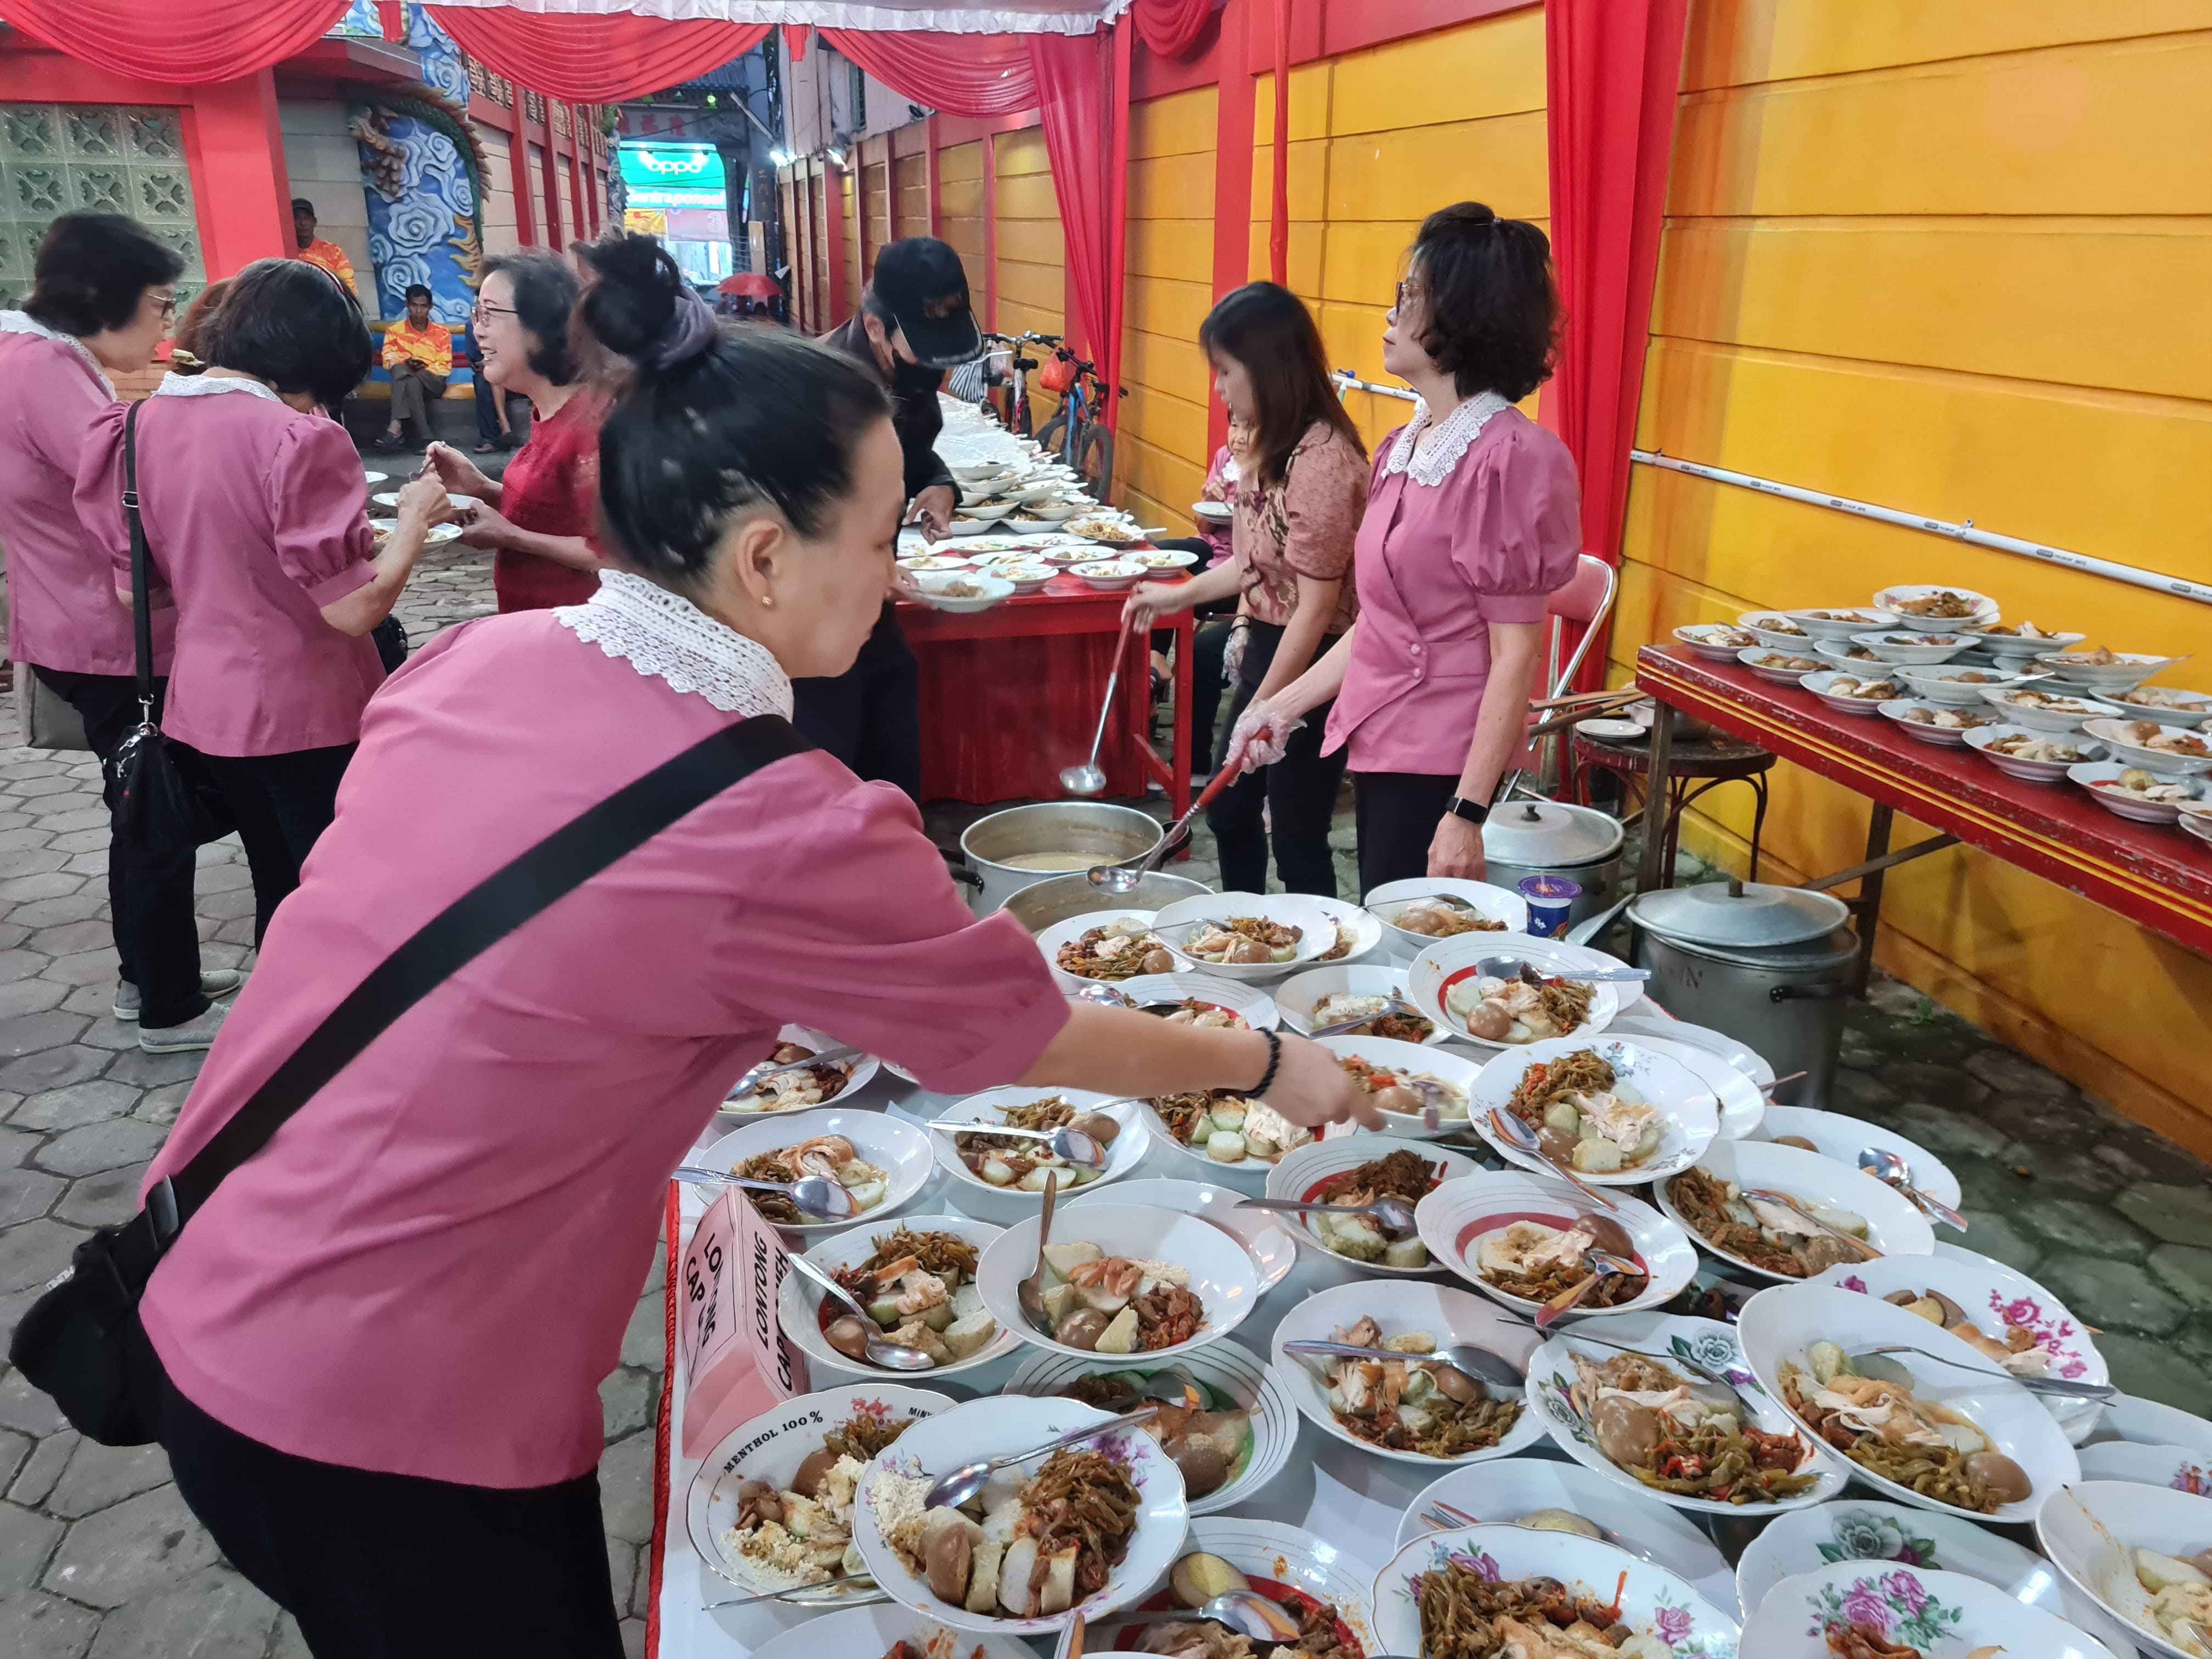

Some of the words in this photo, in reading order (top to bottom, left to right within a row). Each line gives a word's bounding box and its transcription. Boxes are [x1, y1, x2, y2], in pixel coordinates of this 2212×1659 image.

[687, 1256, 705, 1303] CAP
[702, 1232, 723, 1348] LONONG
[755, 1231, 769, 1351] LONTONG
[777, 1336, 792, 1392] CAP
[723, 1429, 778, 1474] MENTHOL
